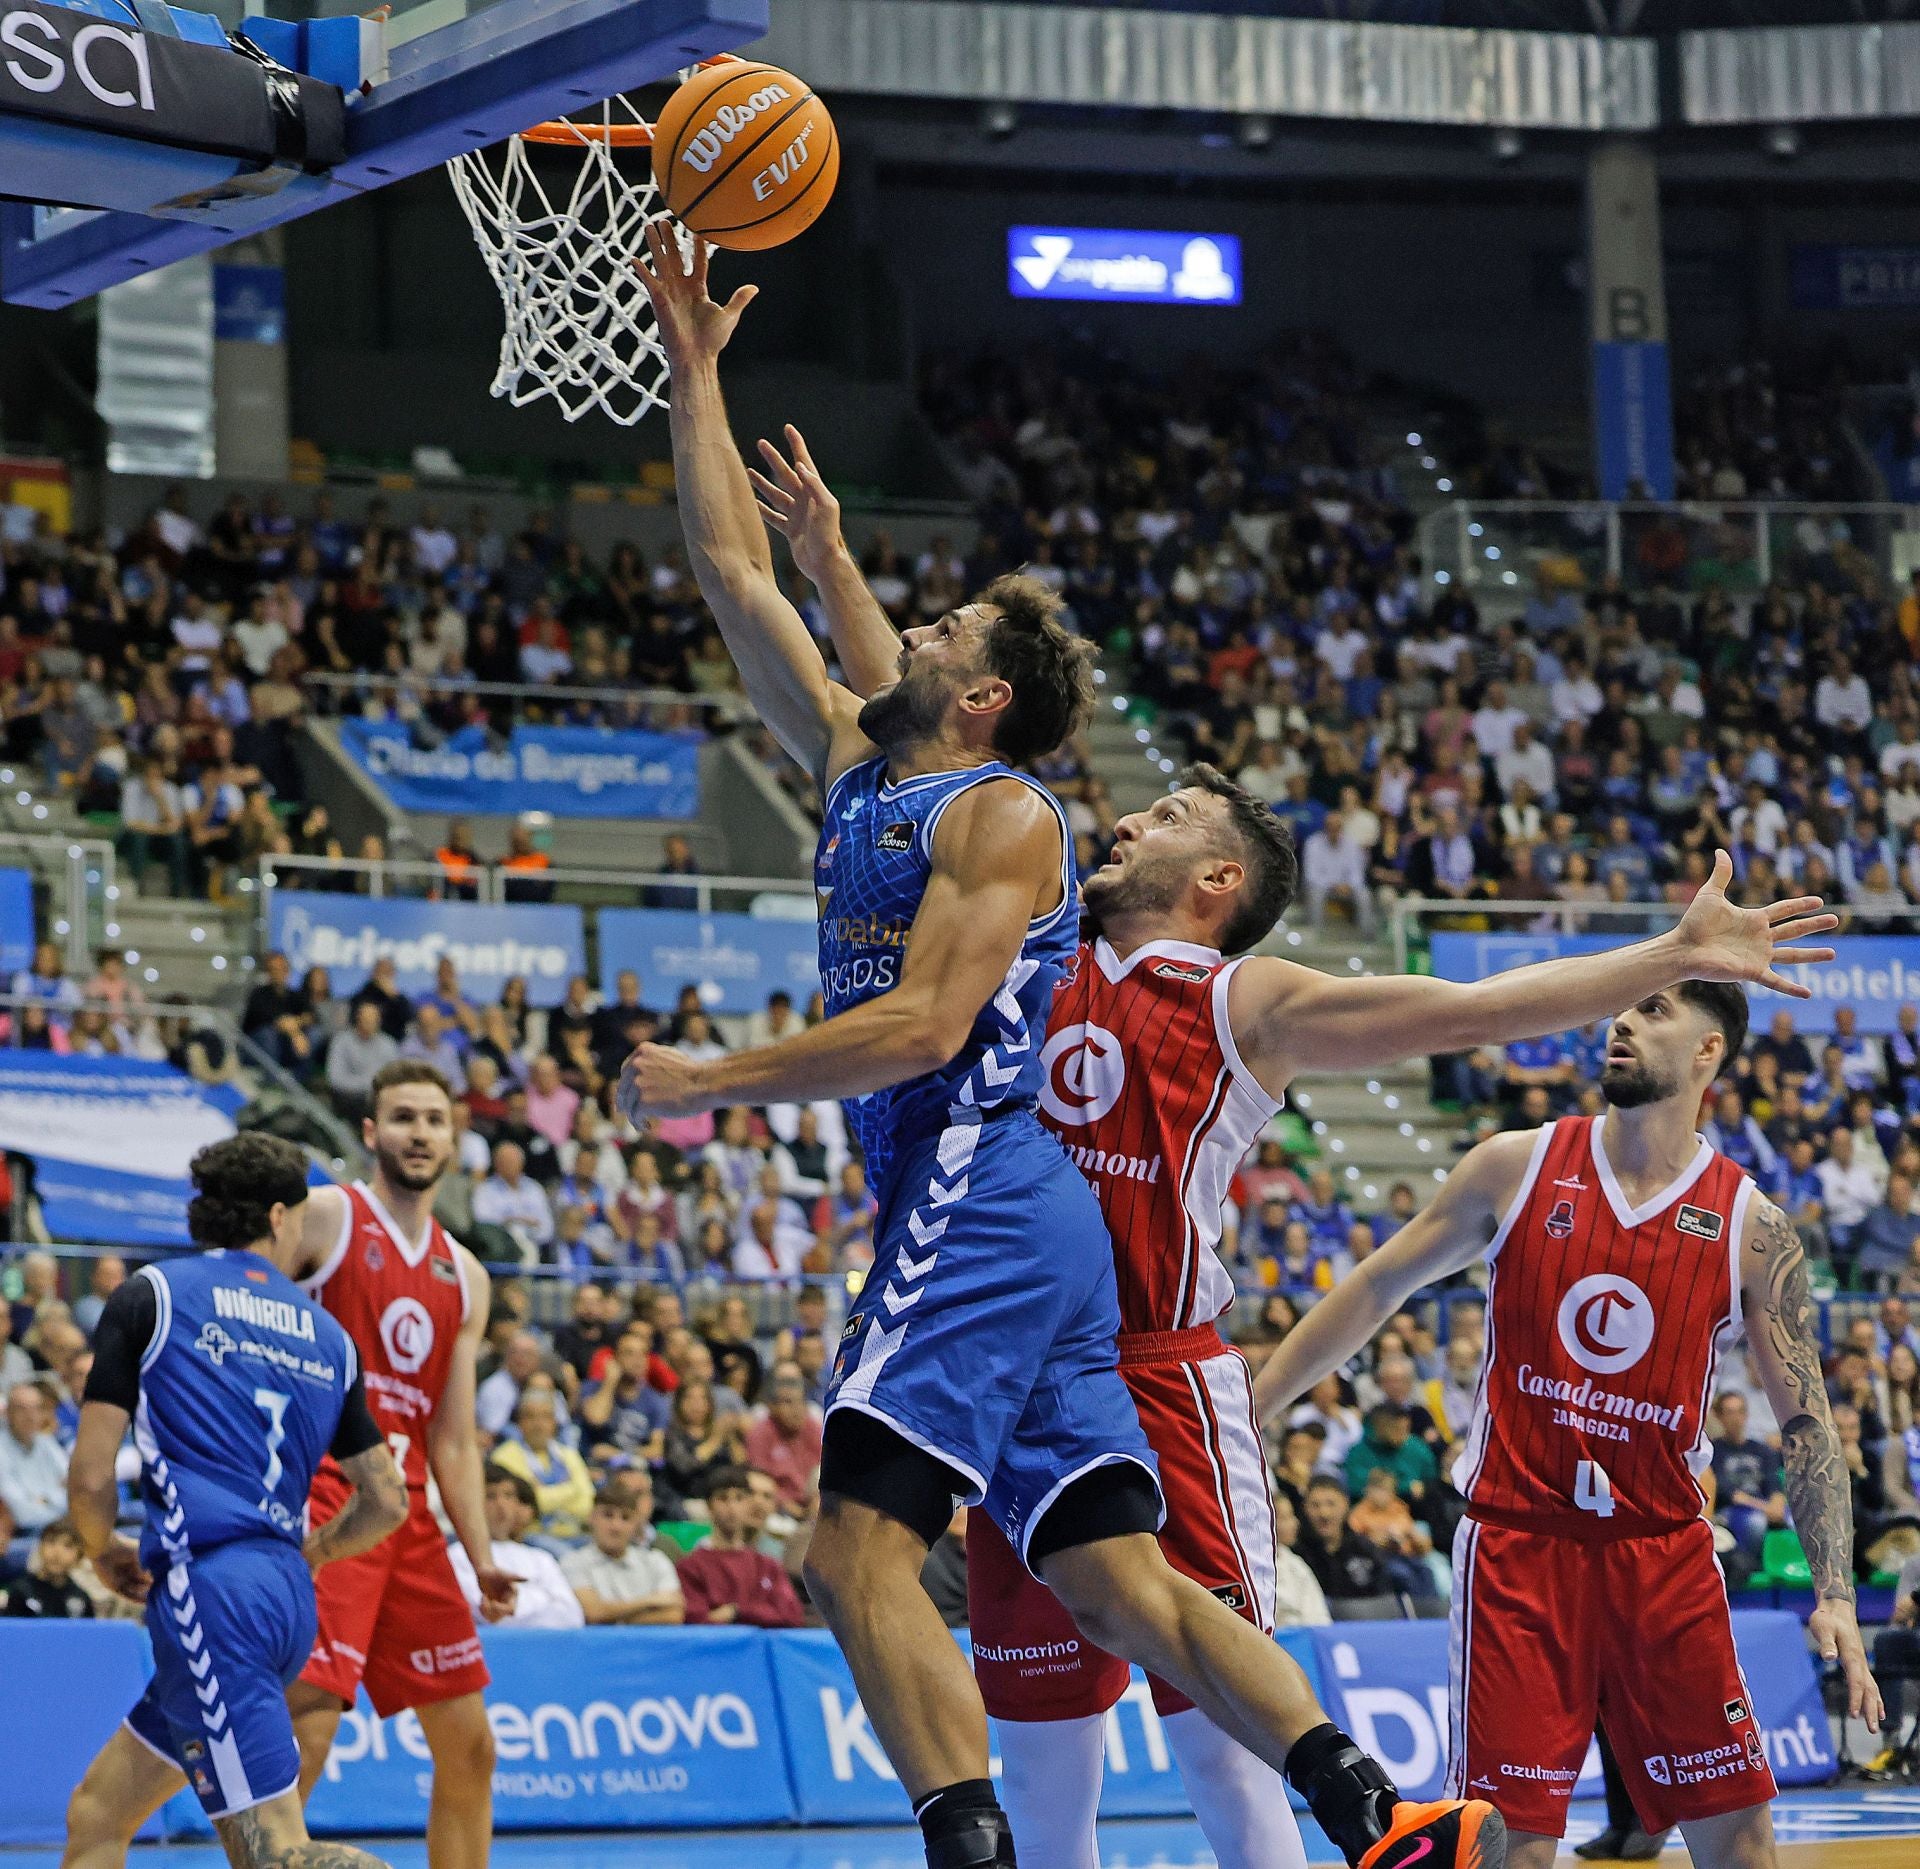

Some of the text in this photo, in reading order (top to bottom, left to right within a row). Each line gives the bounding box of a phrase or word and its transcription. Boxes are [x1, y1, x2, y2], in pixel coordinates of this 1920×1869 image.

[682, 83, 792, 173] Wilson
[212, 1286, 316, 1343] NIÑIROLA
[1517, 1363, 1685, 1433] Casademont
[253, 1387, 293, 1493] 7
[1552, 1407, 1630, 1443] ZARAGOZA
[1573, 1459, 1616, 1518] 4
[973, 1639, 1079, 1662] azulmarino
[1019, 1657, 1081, 1678] new travel
[1729, 1708, 1744, 1721] acb
[325, 1693, 759, 1783] preennova
[1671, 1742, 1742, 1768] Zaragoza
[579, 1772, 597, 1795] Y
[601, 1766, 689, 1797] SALUD
[1500, 1763, 1578, 1781] azulmarino
